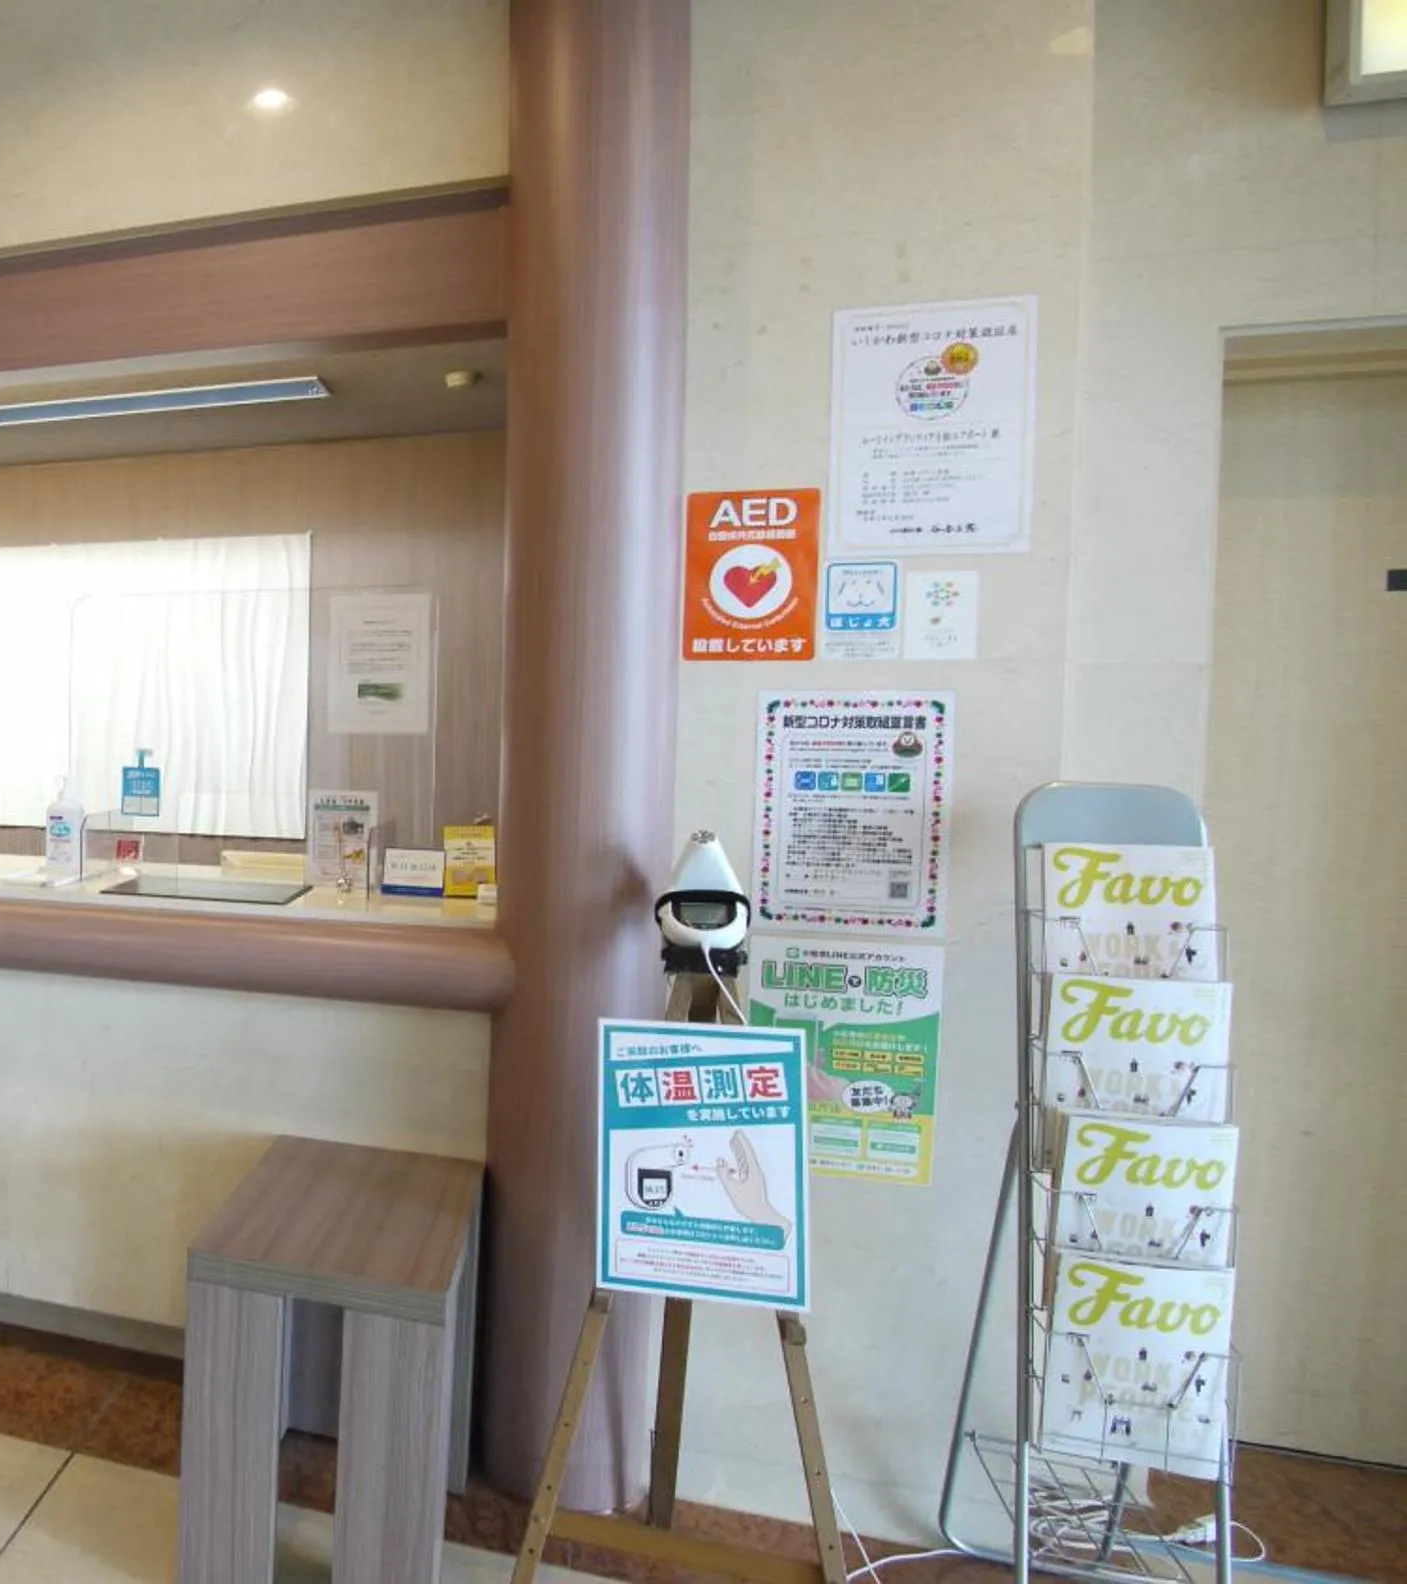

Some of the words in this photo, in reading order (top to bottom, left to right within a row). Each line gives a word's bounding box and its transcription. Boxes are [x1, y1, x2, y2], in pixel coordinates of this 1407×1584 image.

[709, 497, 798, 528] AED
[1052, 847, 1204, 908] Favo
[762, 960, 929, 998] LINEで防災
[1059, 978, 1213, 1046] Favo
[620, 1065, 783, 1104] 体温測定
[1076, 1123, 1227, 1191] Favo
[1067, 1262, 1221, 1335] Favo
